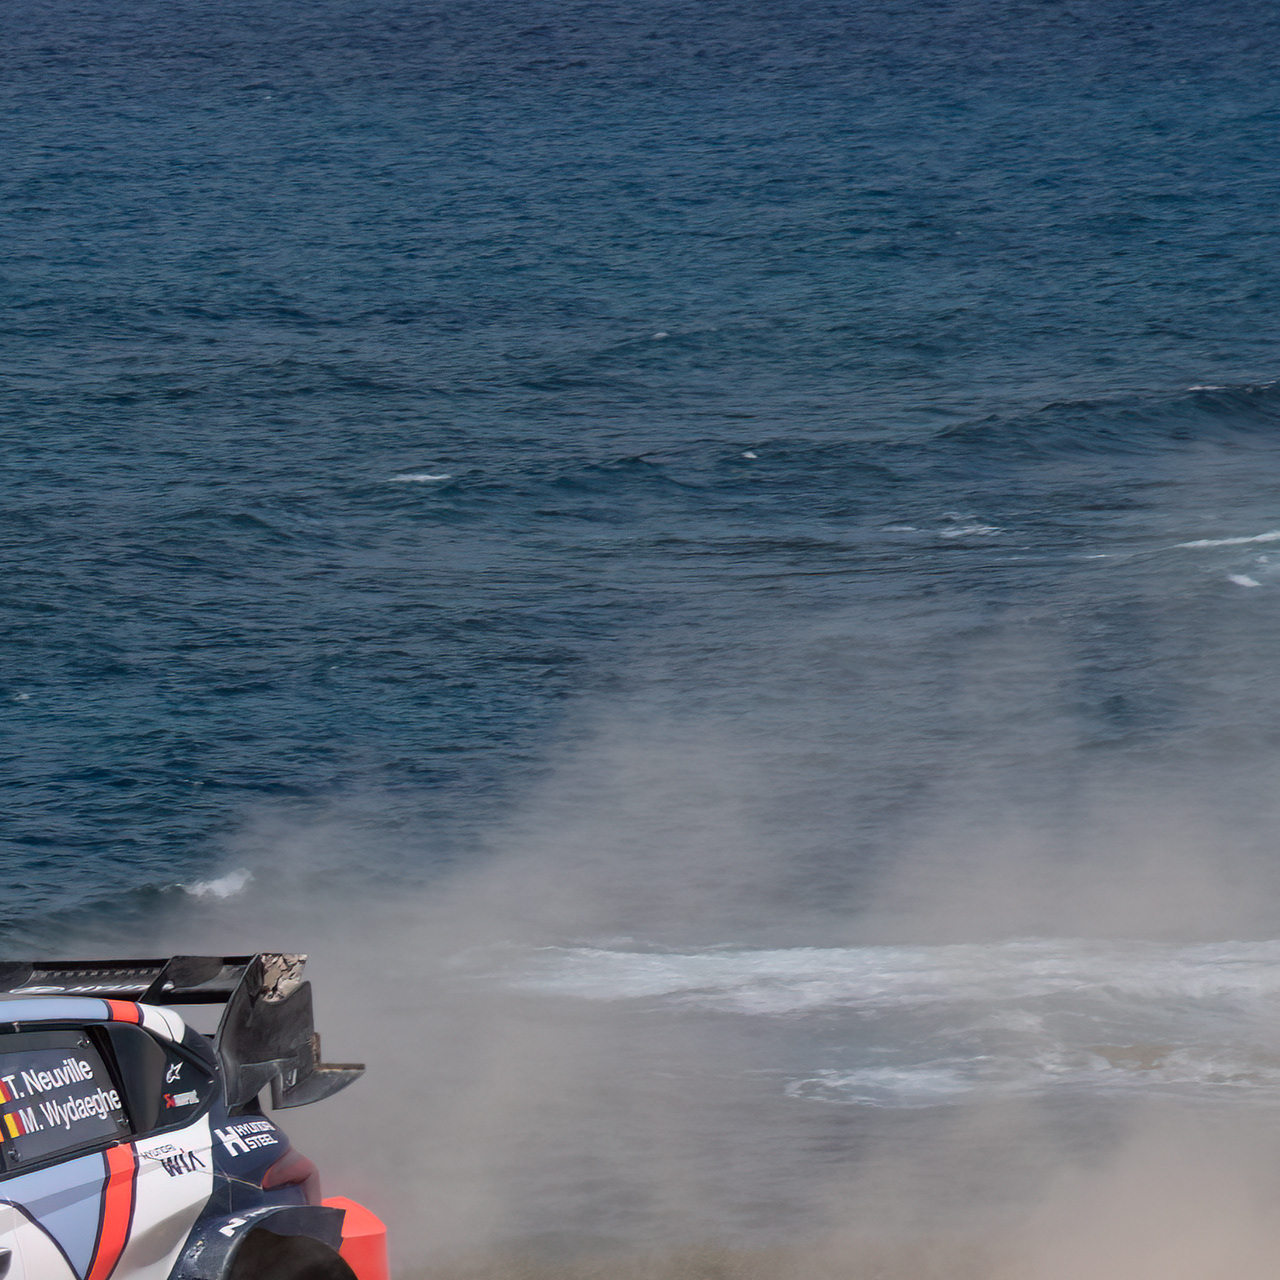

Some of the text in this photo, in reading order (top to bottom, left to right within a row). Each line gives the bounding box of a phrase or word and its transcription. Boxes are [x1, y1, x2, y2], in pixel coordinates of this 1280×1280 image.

[2, 1057, 93, 1099] T. Neuville
[18, 1087, 122, 1134] M. Wydaeghe
[244, 1133, 279, 1149] STEEL
